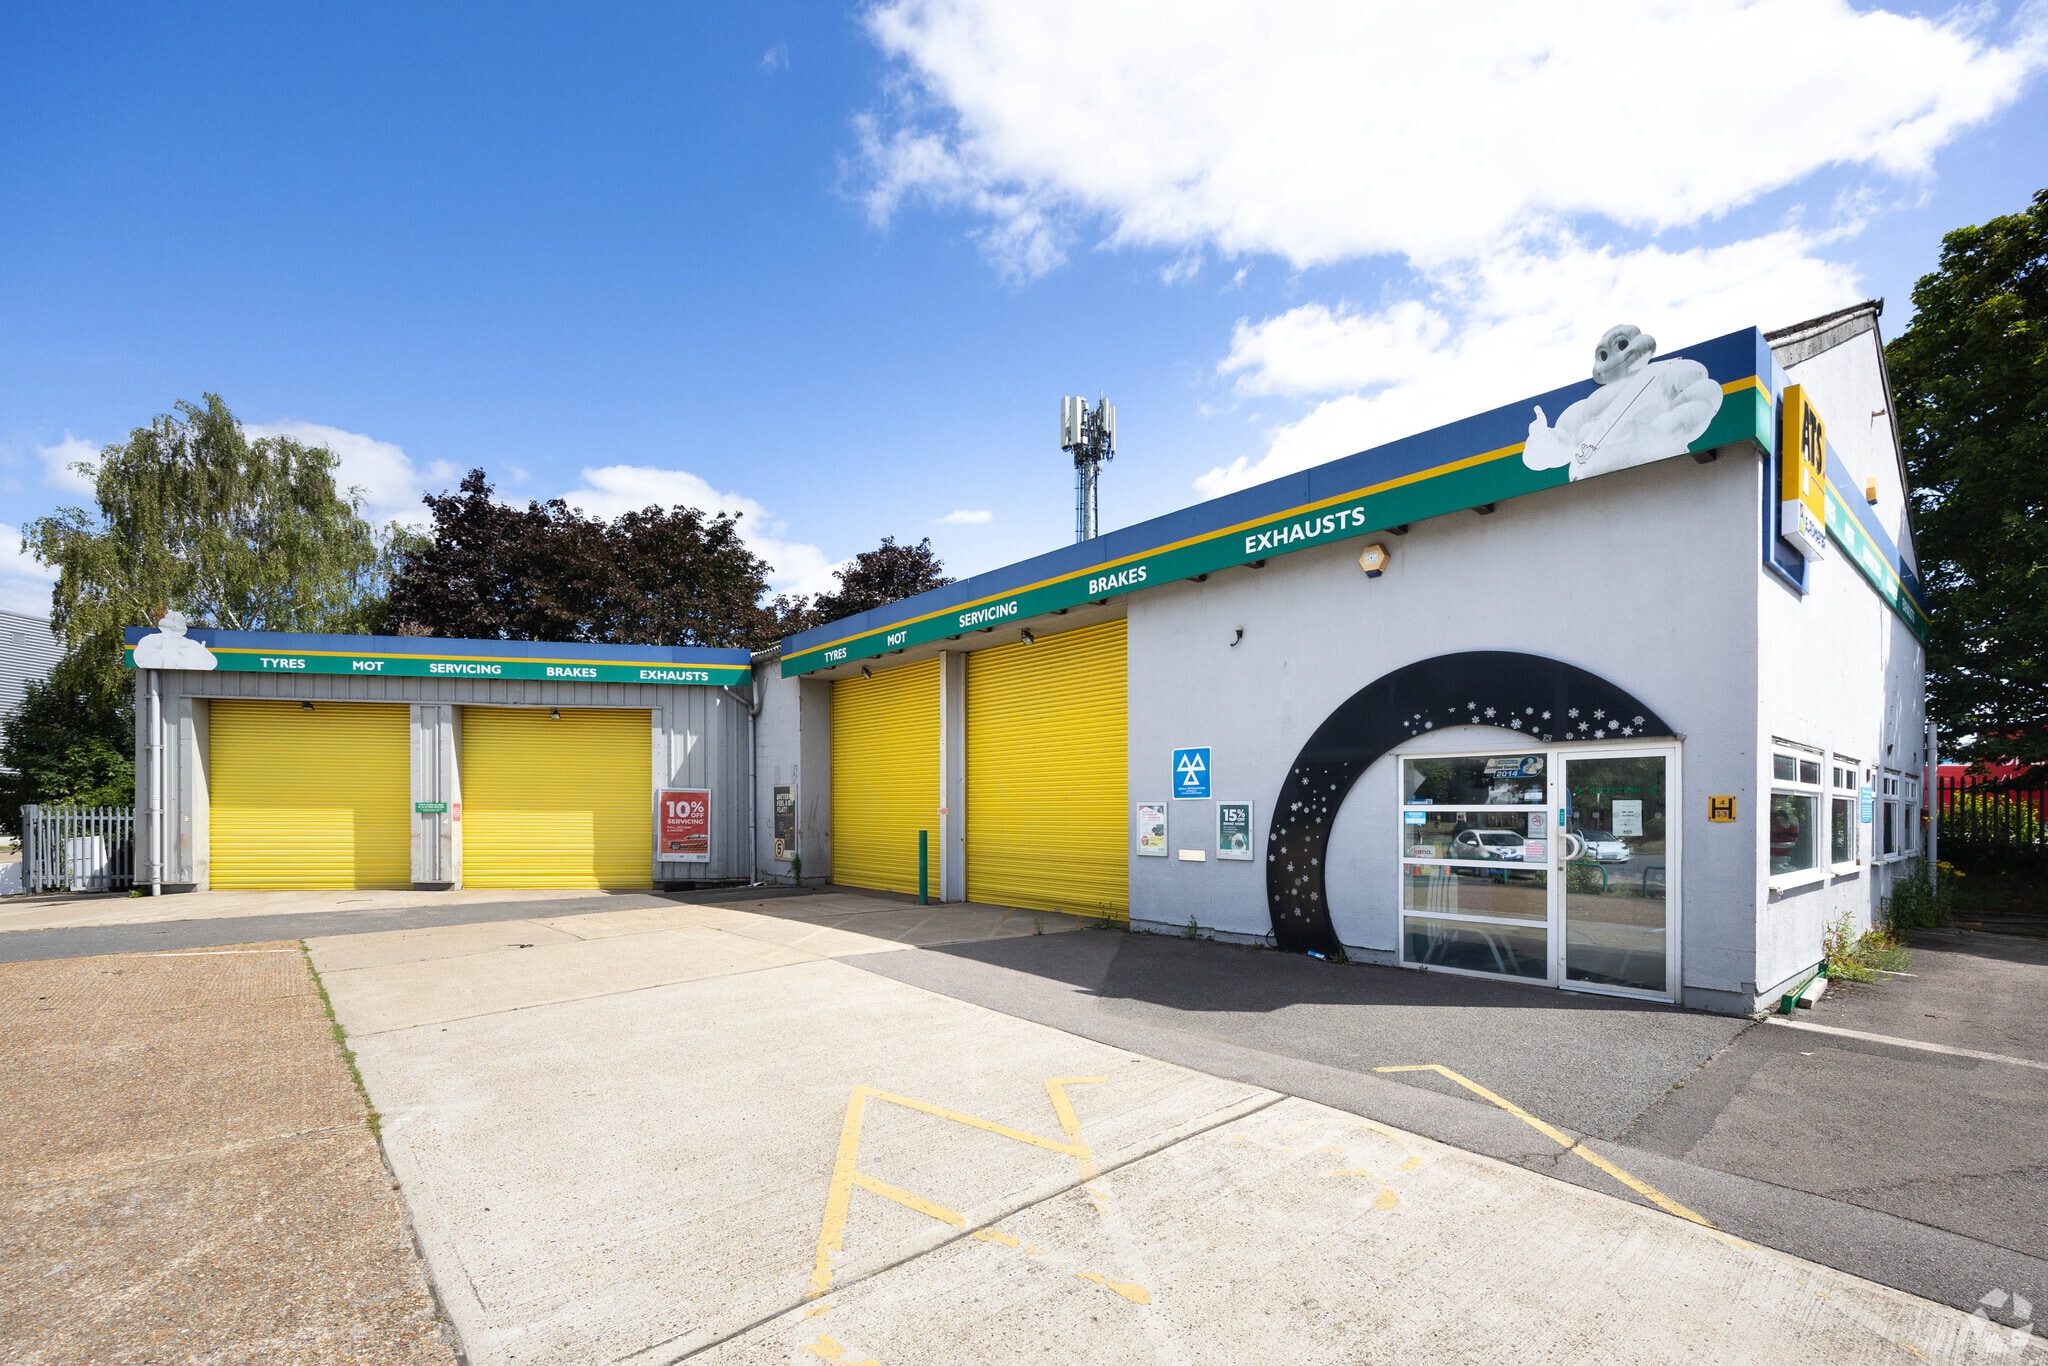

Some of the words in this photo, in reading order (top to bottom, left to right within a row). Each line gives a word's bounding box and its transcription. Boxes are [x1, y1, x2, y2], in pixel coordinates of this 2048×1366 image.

[1801, 399, 1822, 476] ATS
[825, 647, 847, 663] TYRES
[887, 630, 907, 646] MOT
[959, 601, 1018, 628] SERVICING
[1089, 565, 1147, 595] BRAKES
[1245, 506, 1366, 554] EXHAUSTS
[260, 657, 306, 669] TYRES
[352, 660, 384, 671] MOT
[429, 663, 502, 675] SERVICING
[546, 666, 597, 678] BRAKES
[639, 669, 709, 681] EXHAUSTS
[666, 801, 704, 818] 10%
[1223, 808, 1246, 822] 15%
[777, 843, 782, 855] 5
